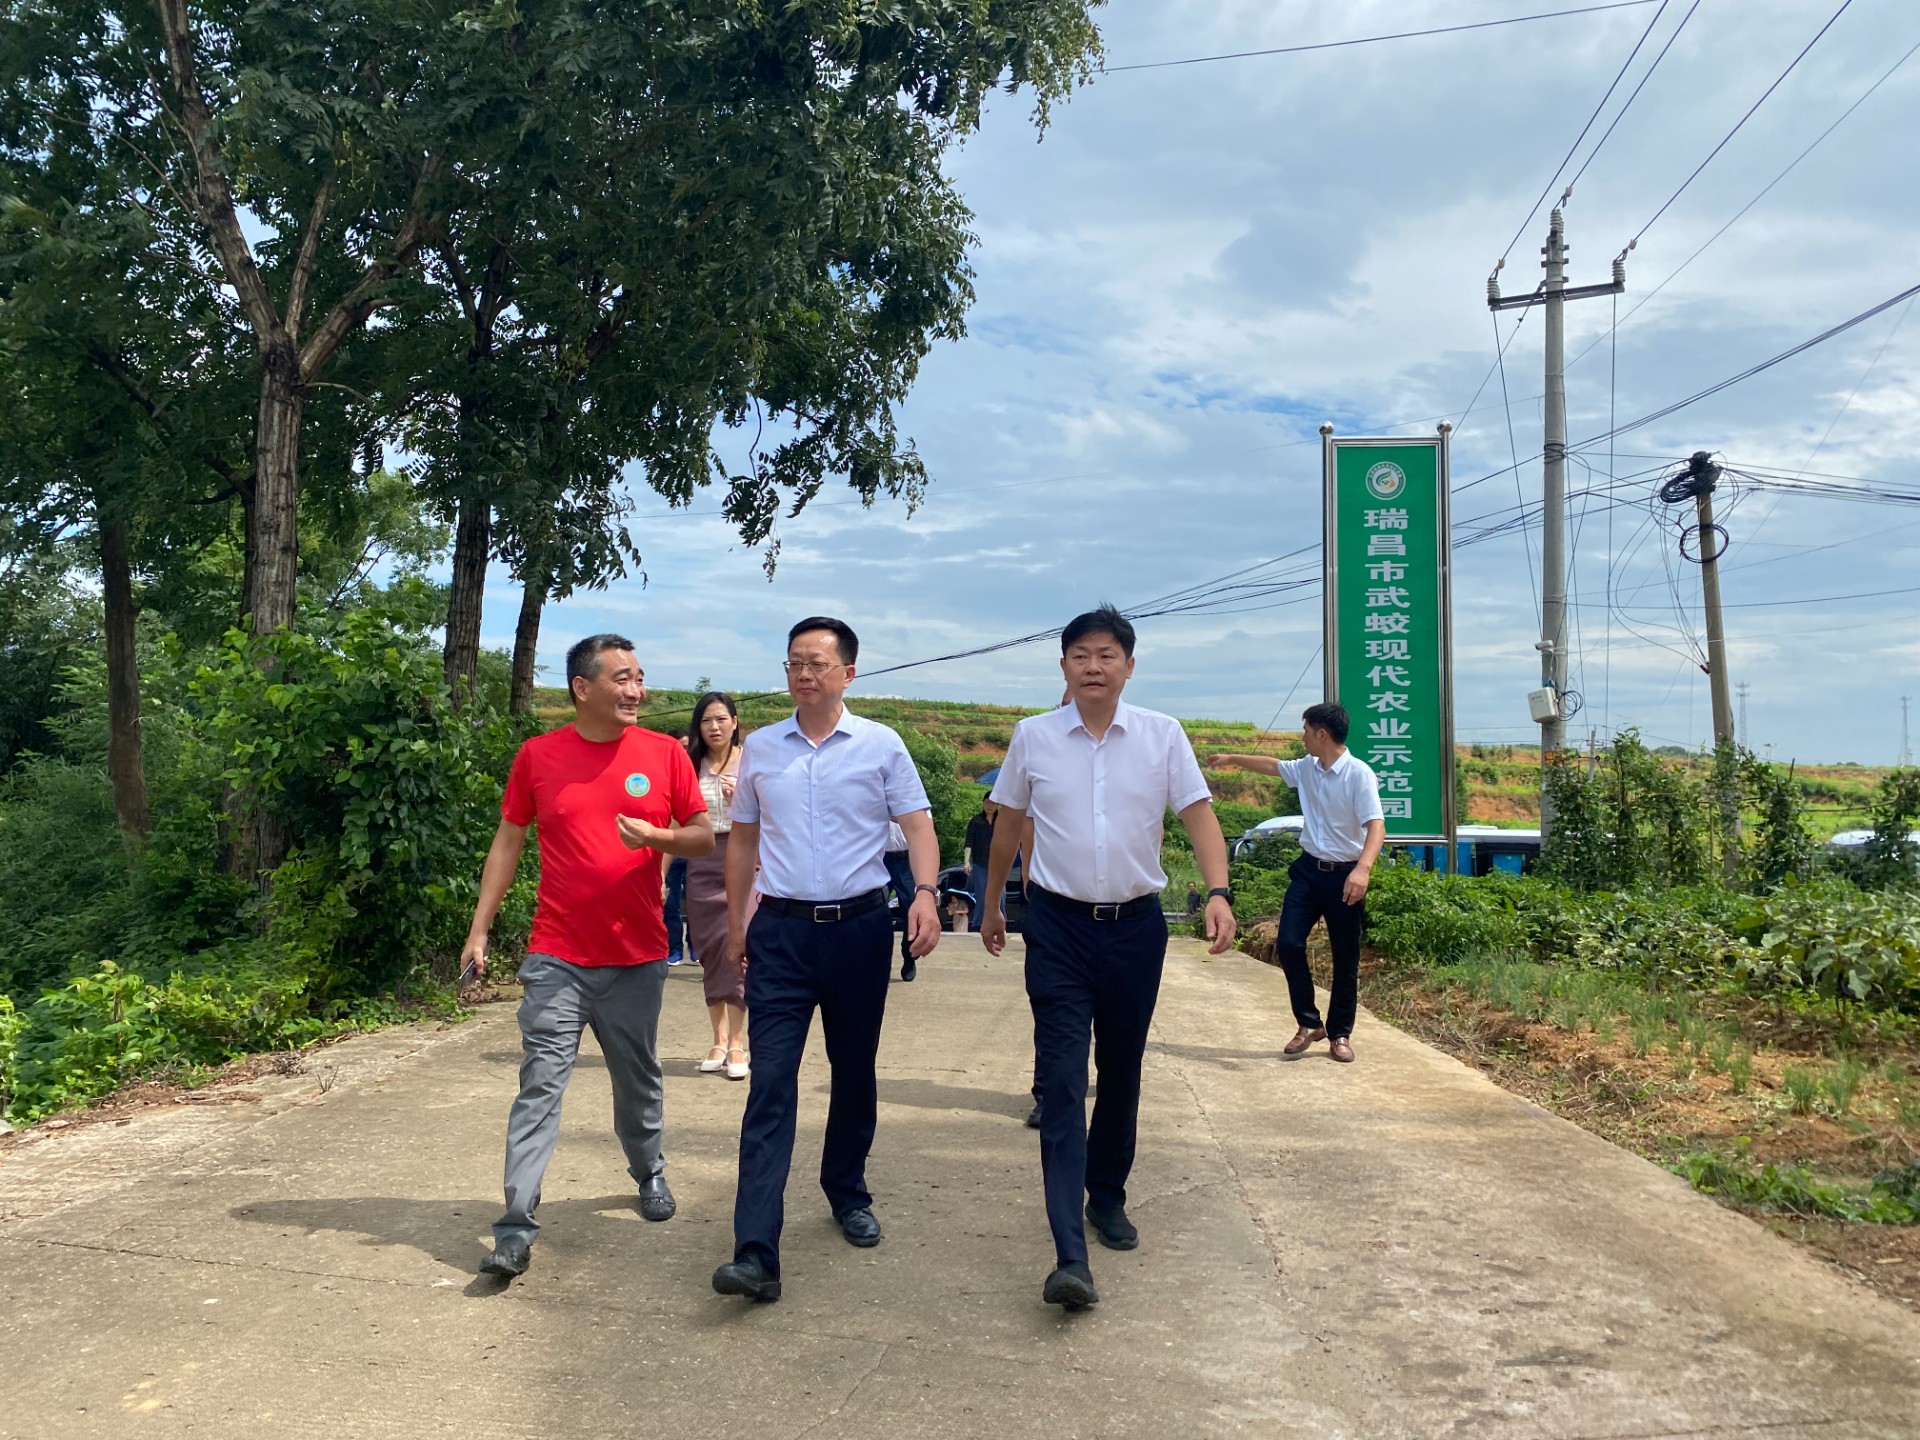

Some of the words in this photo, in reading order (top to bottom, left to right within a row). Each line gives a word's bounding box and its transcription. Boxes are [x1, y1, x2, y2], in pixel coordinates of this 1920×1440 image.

[1364, 508, 1412, 818] 瑞昌市武蛟现代农业示范园
